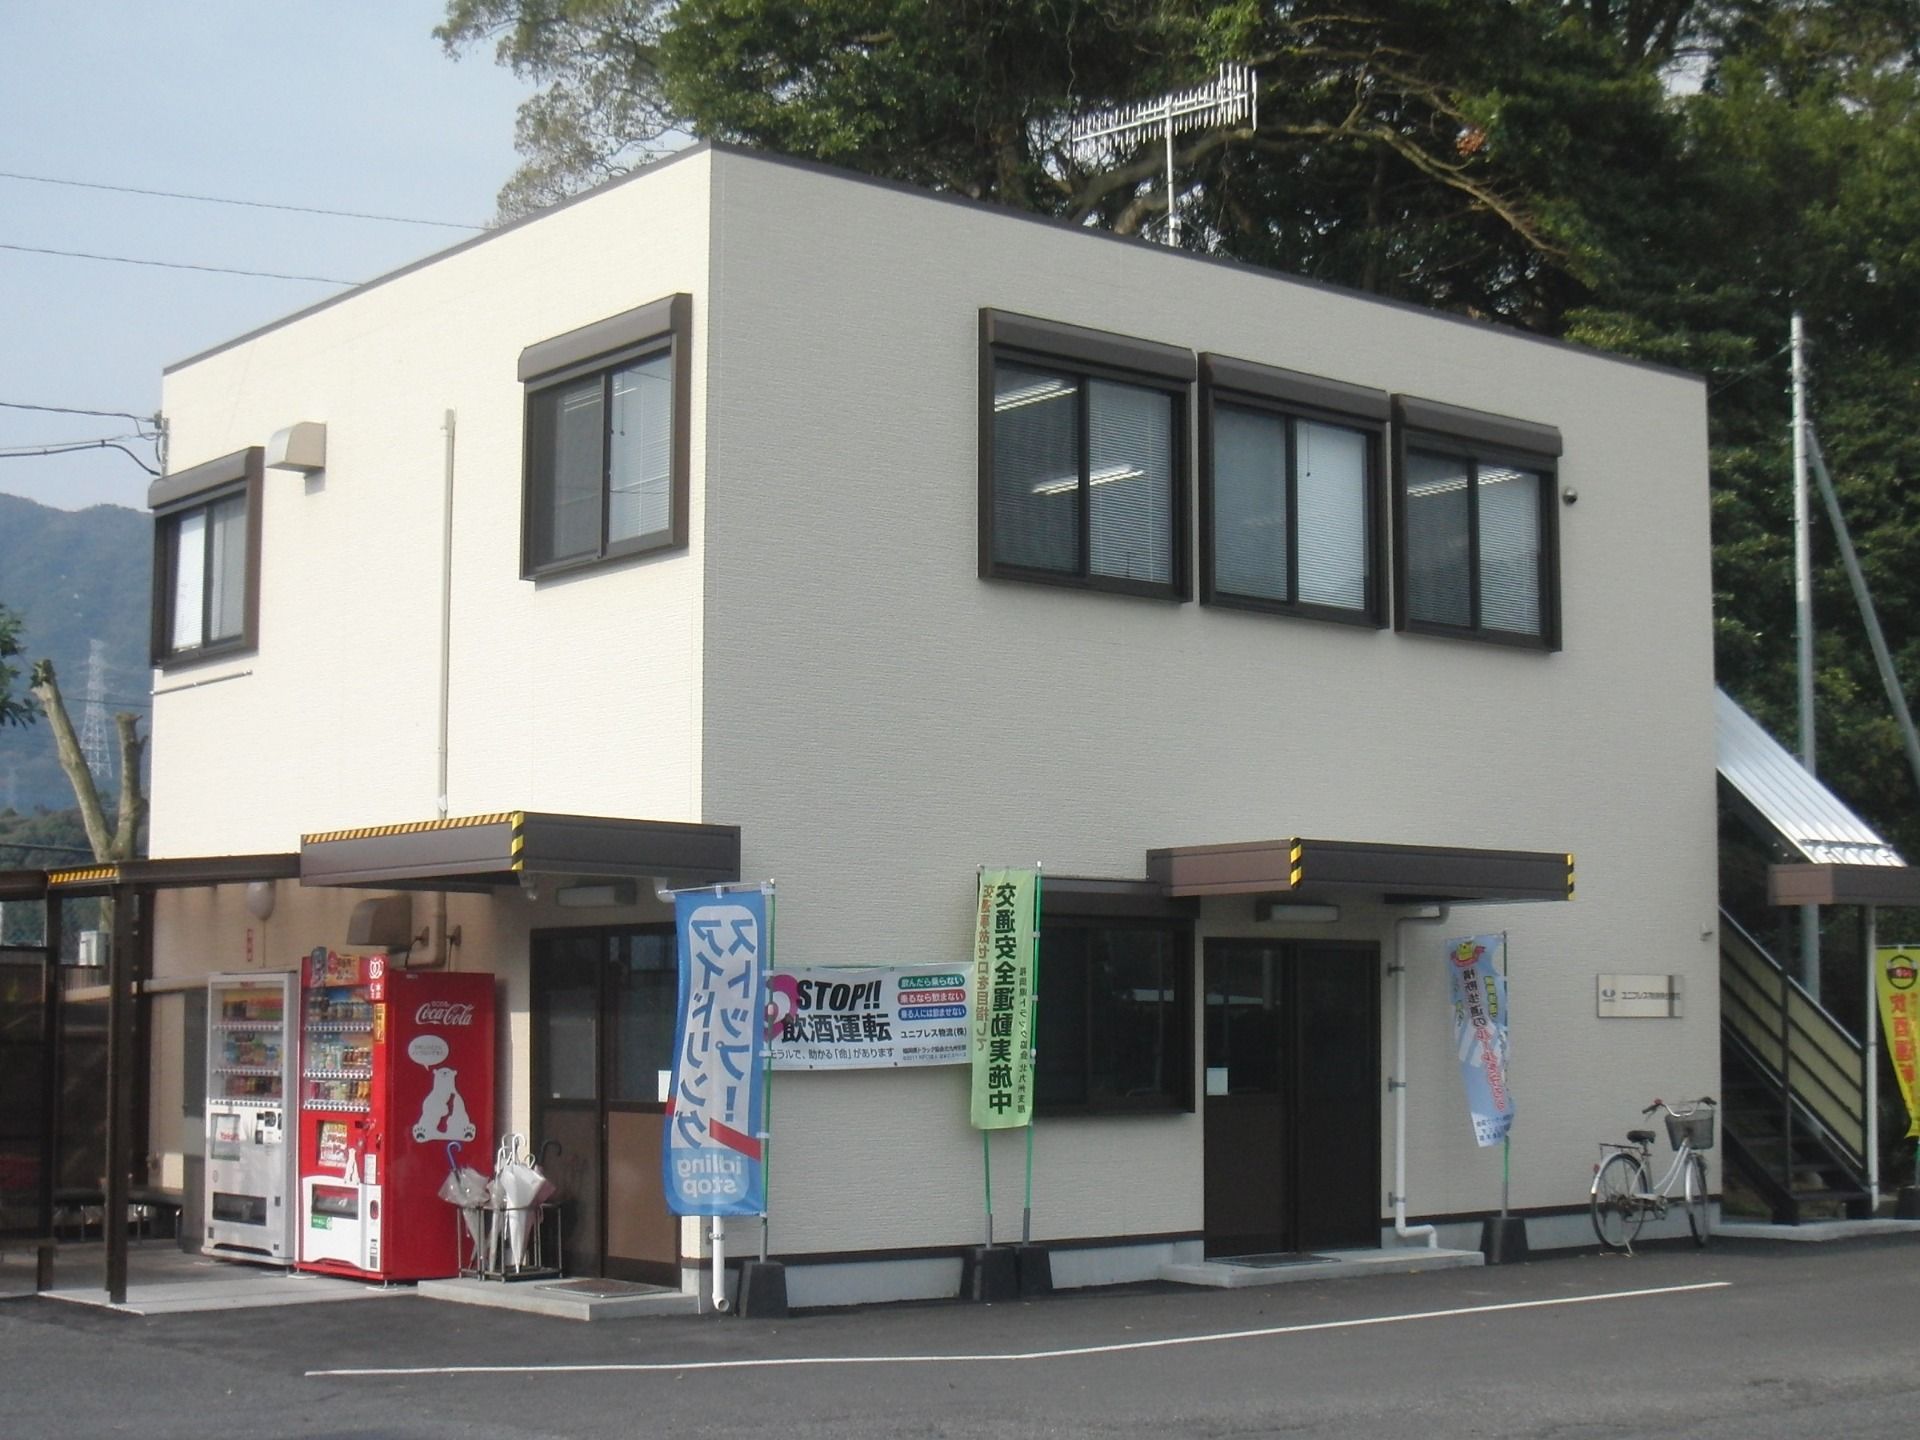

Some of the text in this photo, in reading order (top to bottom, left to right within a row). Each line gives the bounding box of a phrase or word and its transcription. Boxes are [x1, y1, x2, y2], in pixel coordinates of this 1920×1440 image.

[797, 979, 883, 1012] STOP!!
[415, 1003, 475, 1026] Coca-Cola
[781, 1013, 893, 1044] 飲酒運転
